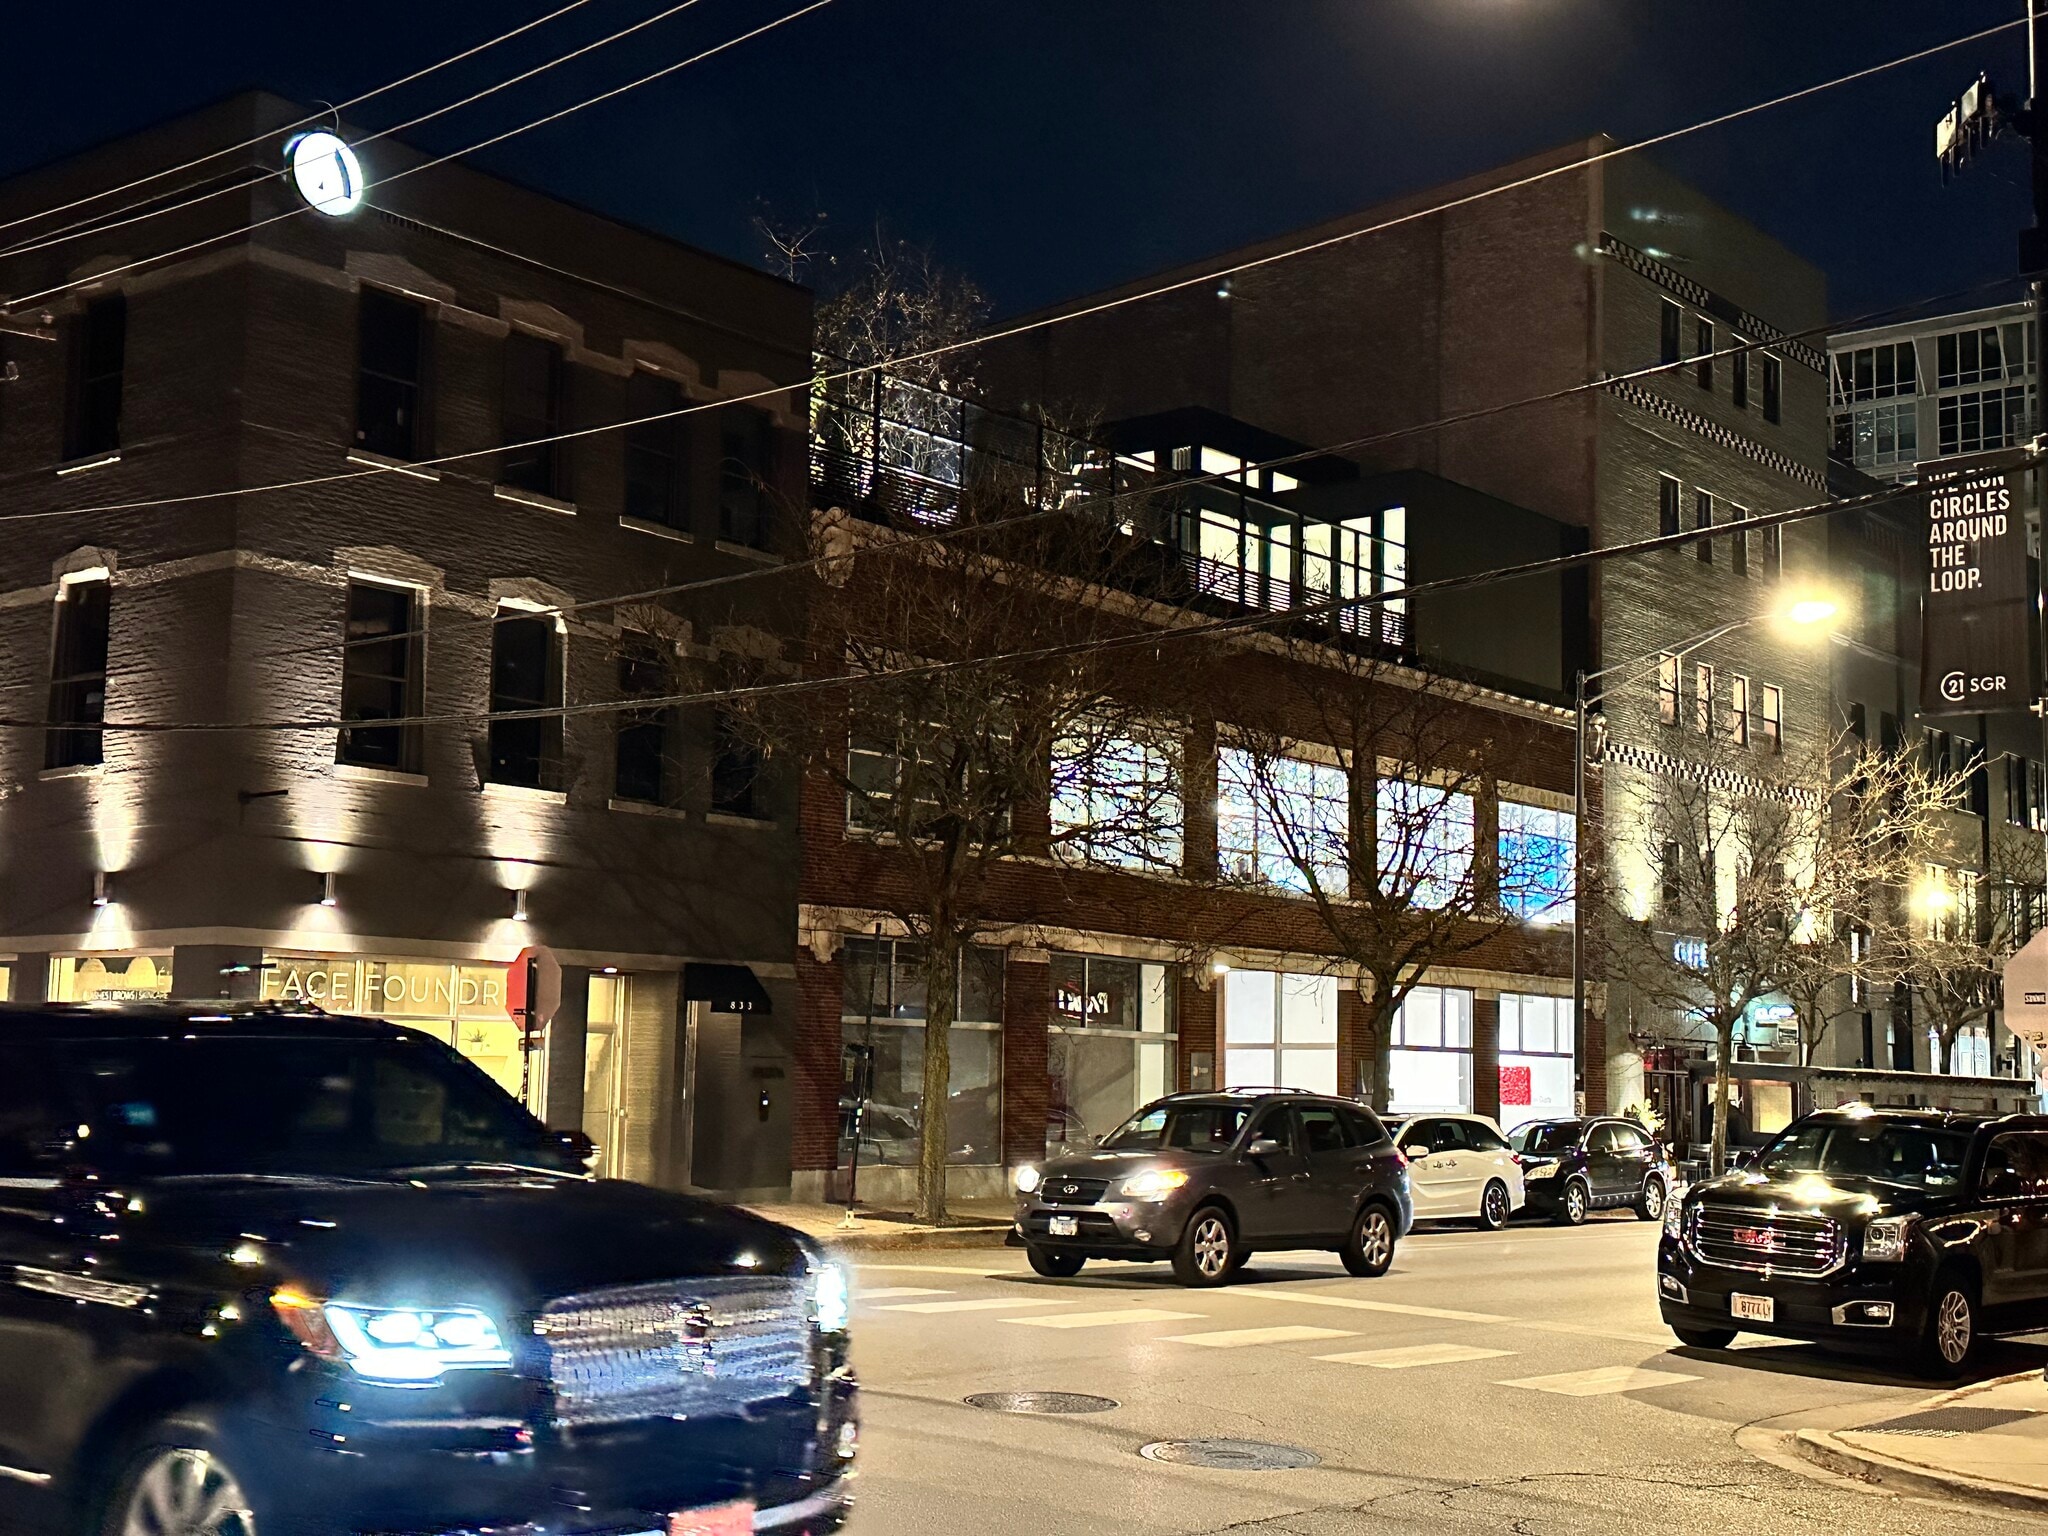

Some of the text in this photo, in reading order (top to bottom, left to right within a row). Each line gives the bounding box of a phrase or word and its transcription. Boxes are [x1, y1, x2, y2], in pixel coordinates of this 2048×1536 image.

[1930, 489, 2010, 519] CIRCLES
[1929, 514, 2007, 544] AROUND
[1929, 544, 1965, 568] THE
[1930, 567, 1982, 592] LOOP.
[1970, 675, 2007, 692] SGR
[262, 969, 501, 1006] FACE FOUNDR
